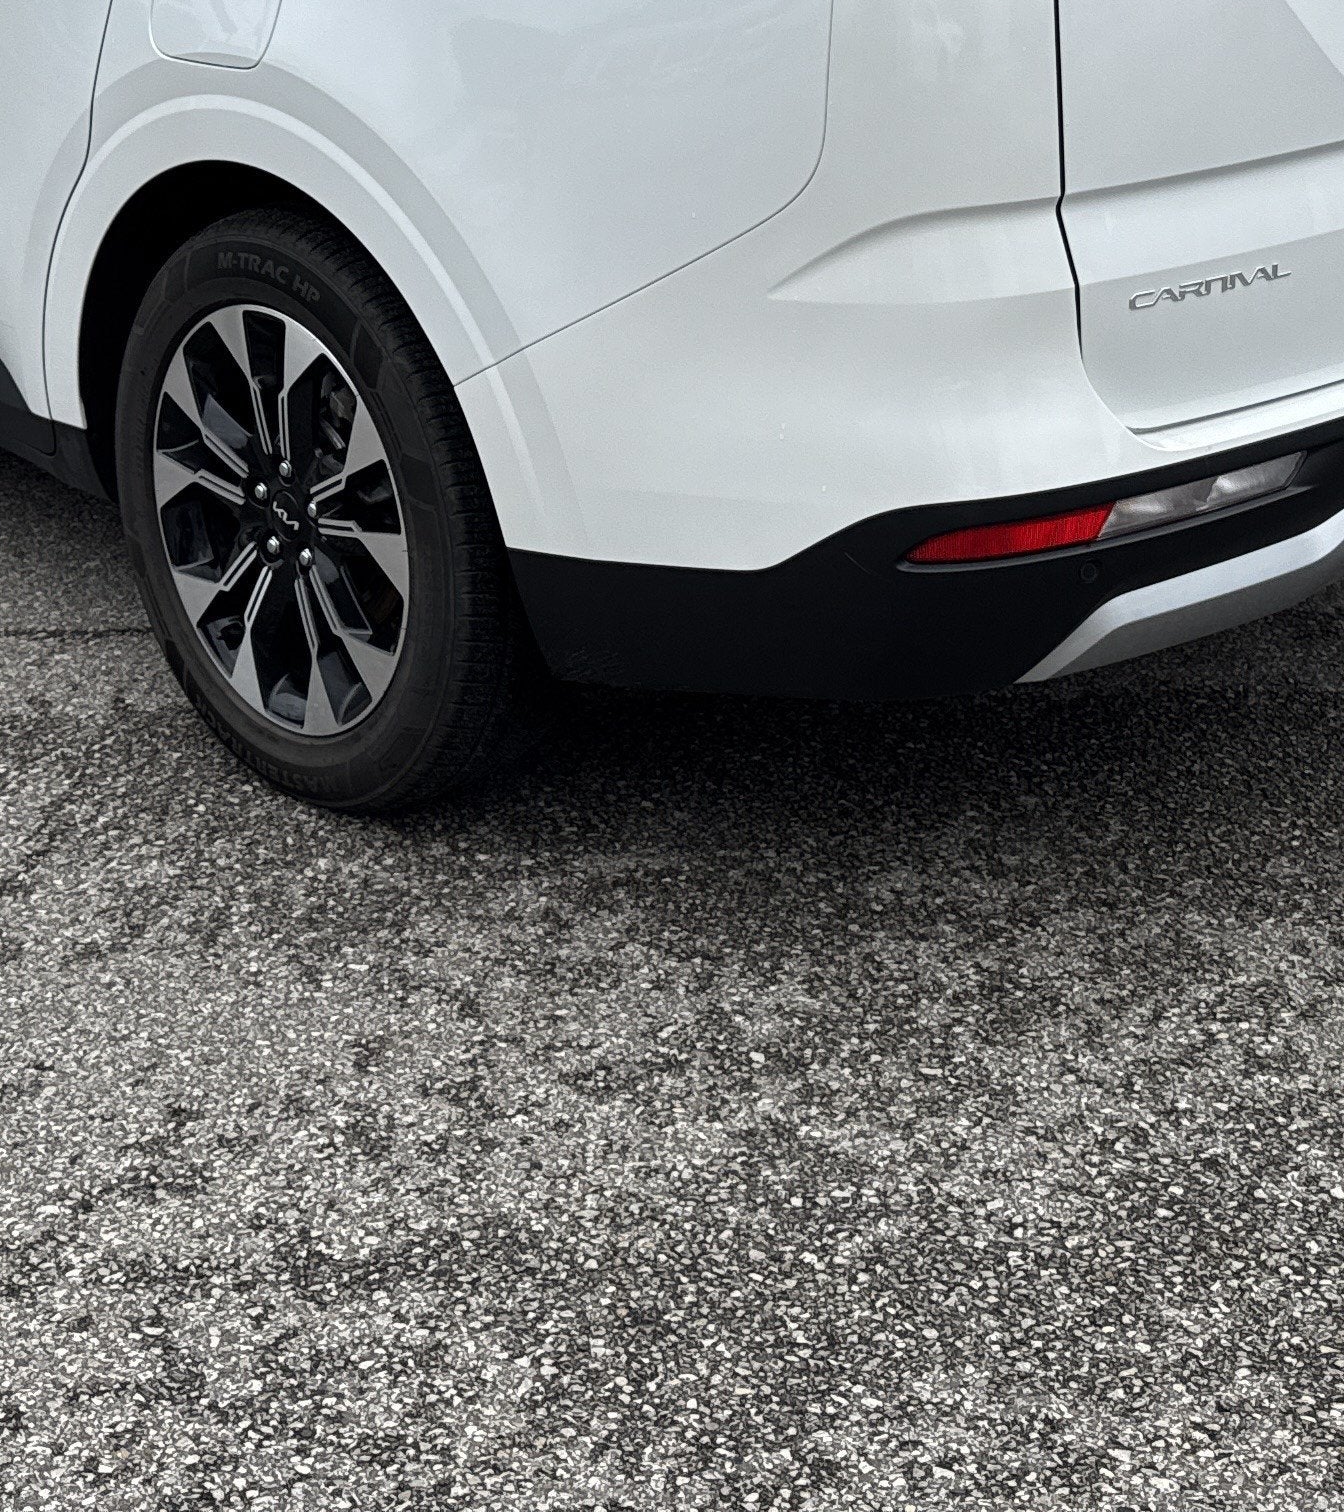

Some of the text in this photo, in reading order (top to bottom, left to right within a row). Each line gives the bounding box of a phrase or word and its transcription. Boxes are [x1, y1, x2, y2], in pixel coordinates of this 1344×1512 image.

[217, 251, 321, 303] M-TRAC HP
[1129, 263, 1292, 311] CARNIVAL
